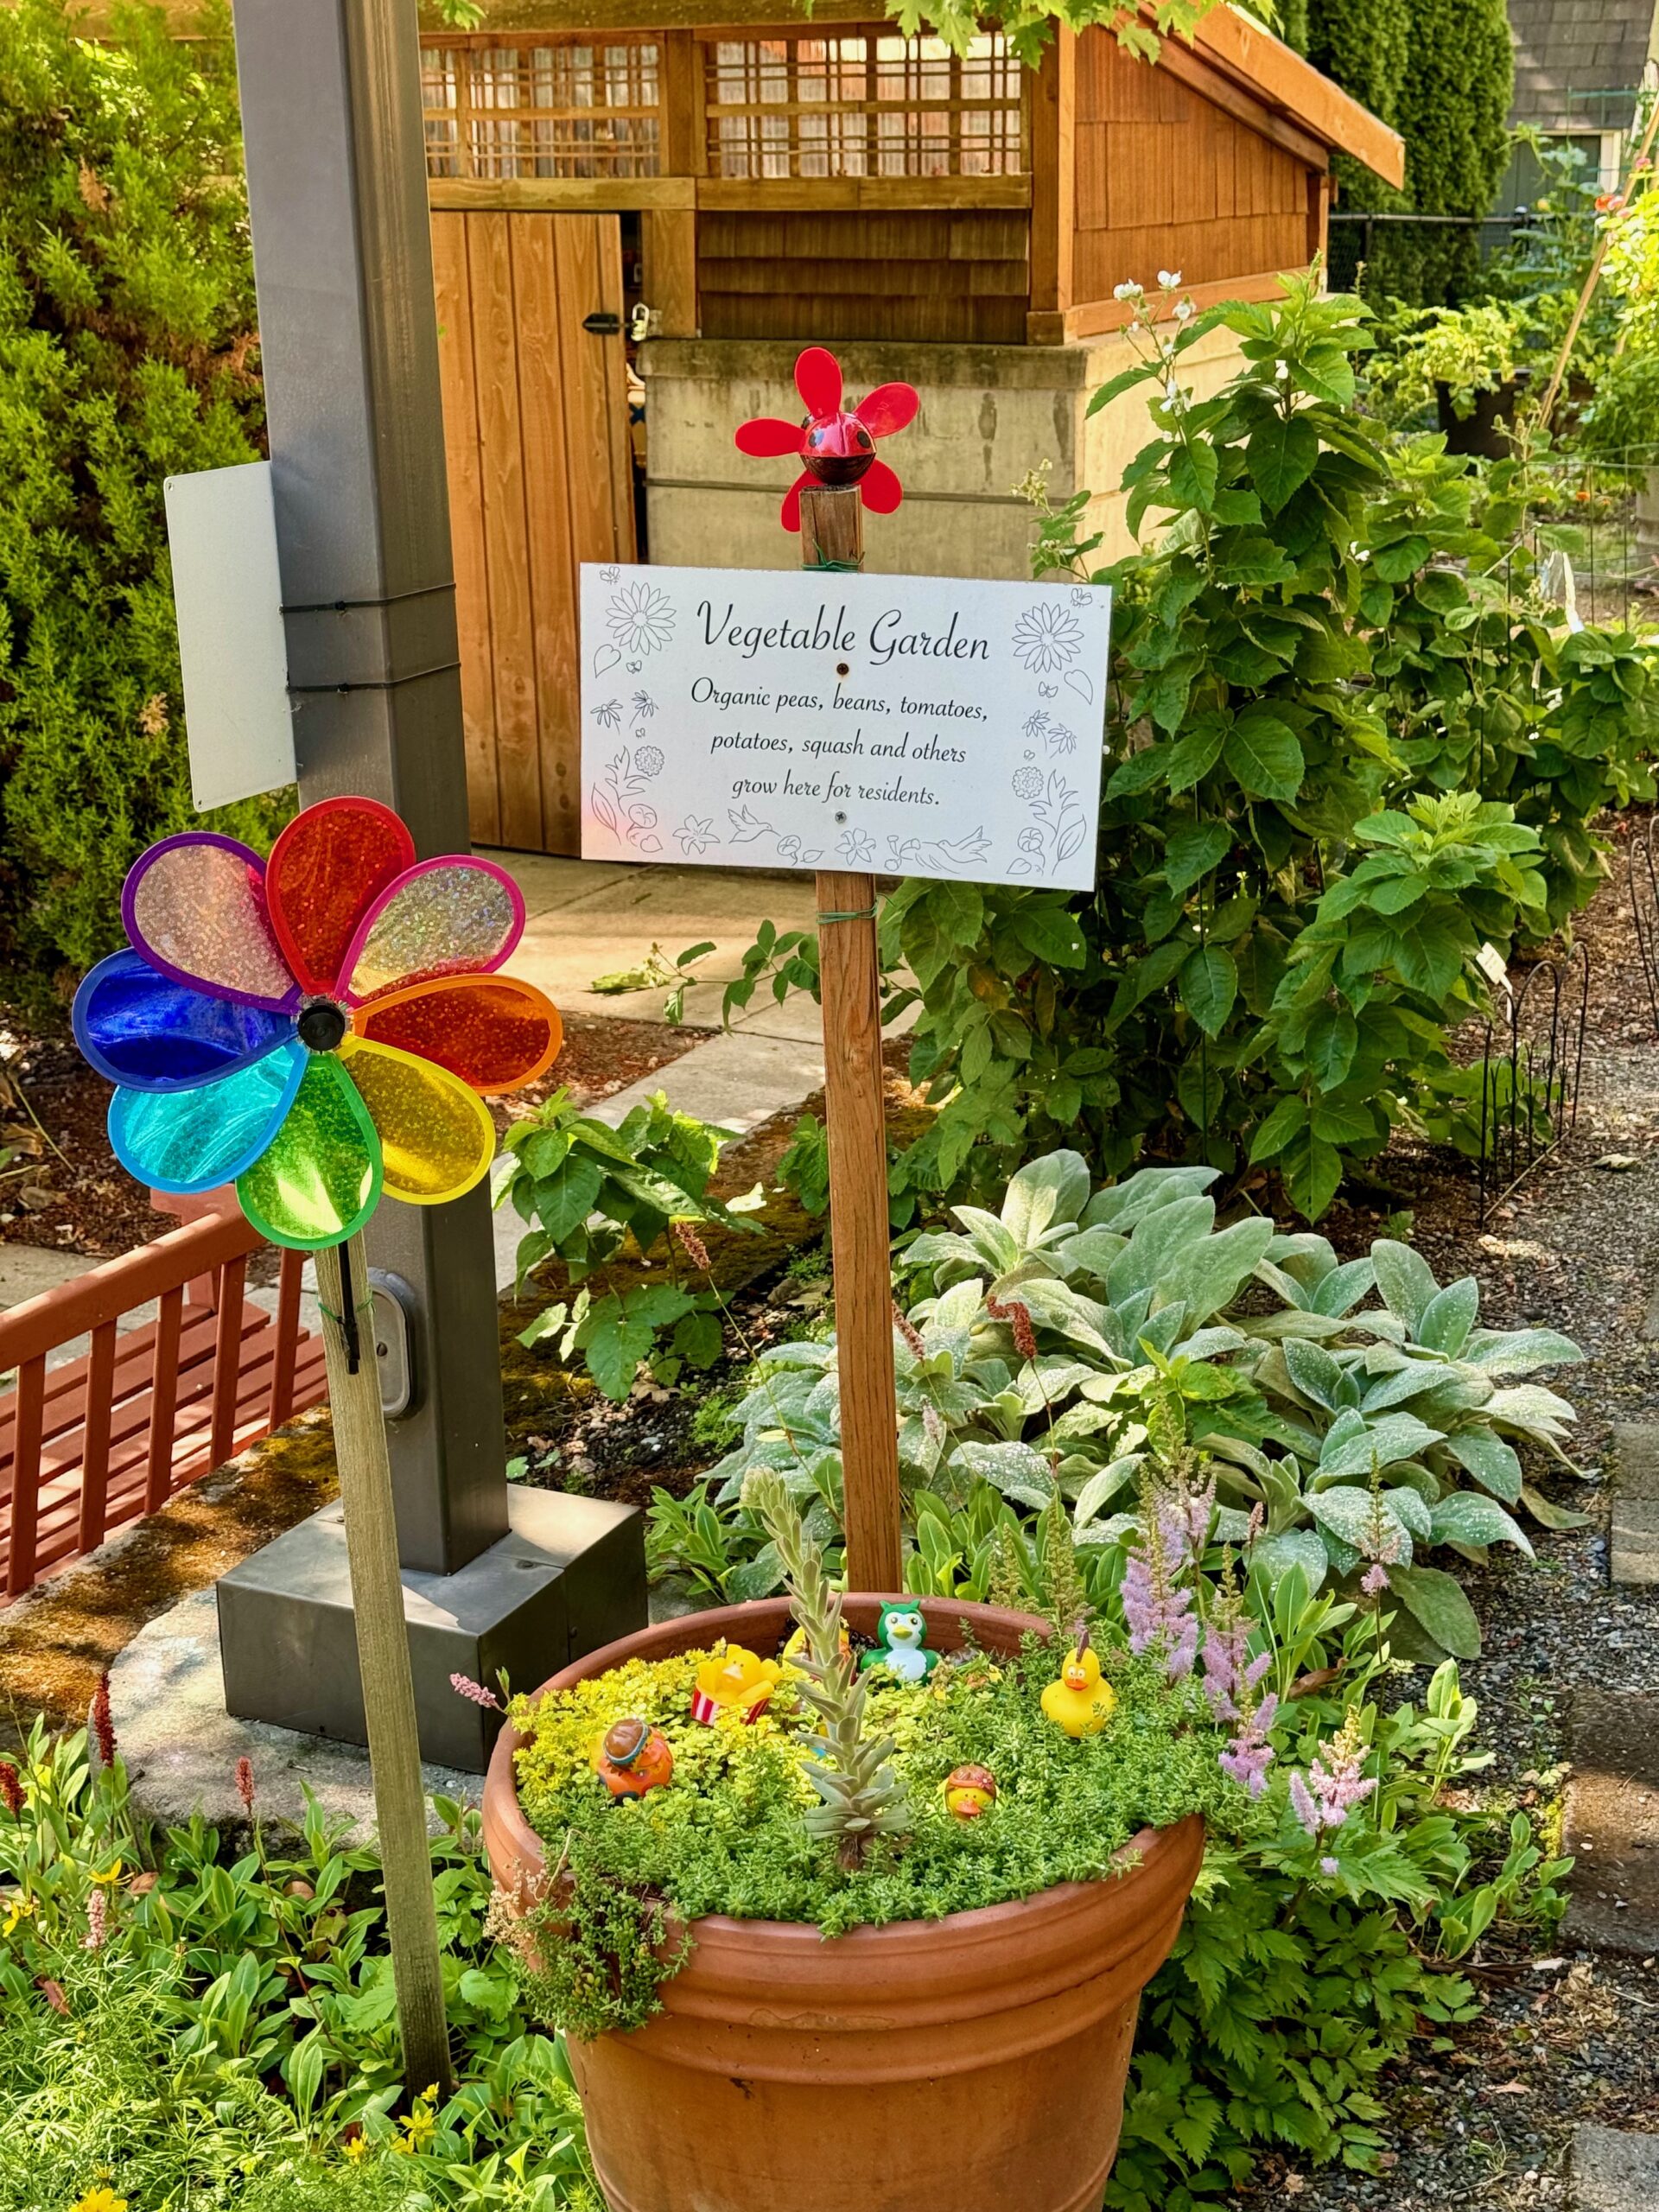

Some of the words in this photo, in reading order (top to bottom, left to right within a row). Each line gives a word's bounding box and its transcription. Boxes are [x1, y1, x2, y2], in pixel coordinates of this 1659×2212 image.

[697, 601, 855, 658] Vegetable
[869, 609, 989, 665] Garden
[691, 677, 771, 711] Organic
[775, 691, 823, 714] peas,
[832, 683, 891, 715] beans,
[899, 695, 988, 721] tomatoes,
[710, 732, 793, 754] potatoes,
[801, 728, 864, 760] squash
[870, 732, 909, 759] and
[912, 734, 966, 763] others
[733, 777, 777, 798] grow
[784, 769, 821, 797] here
[822, 771, 851, 804] for
[858, 776, 940, 805] residents.
